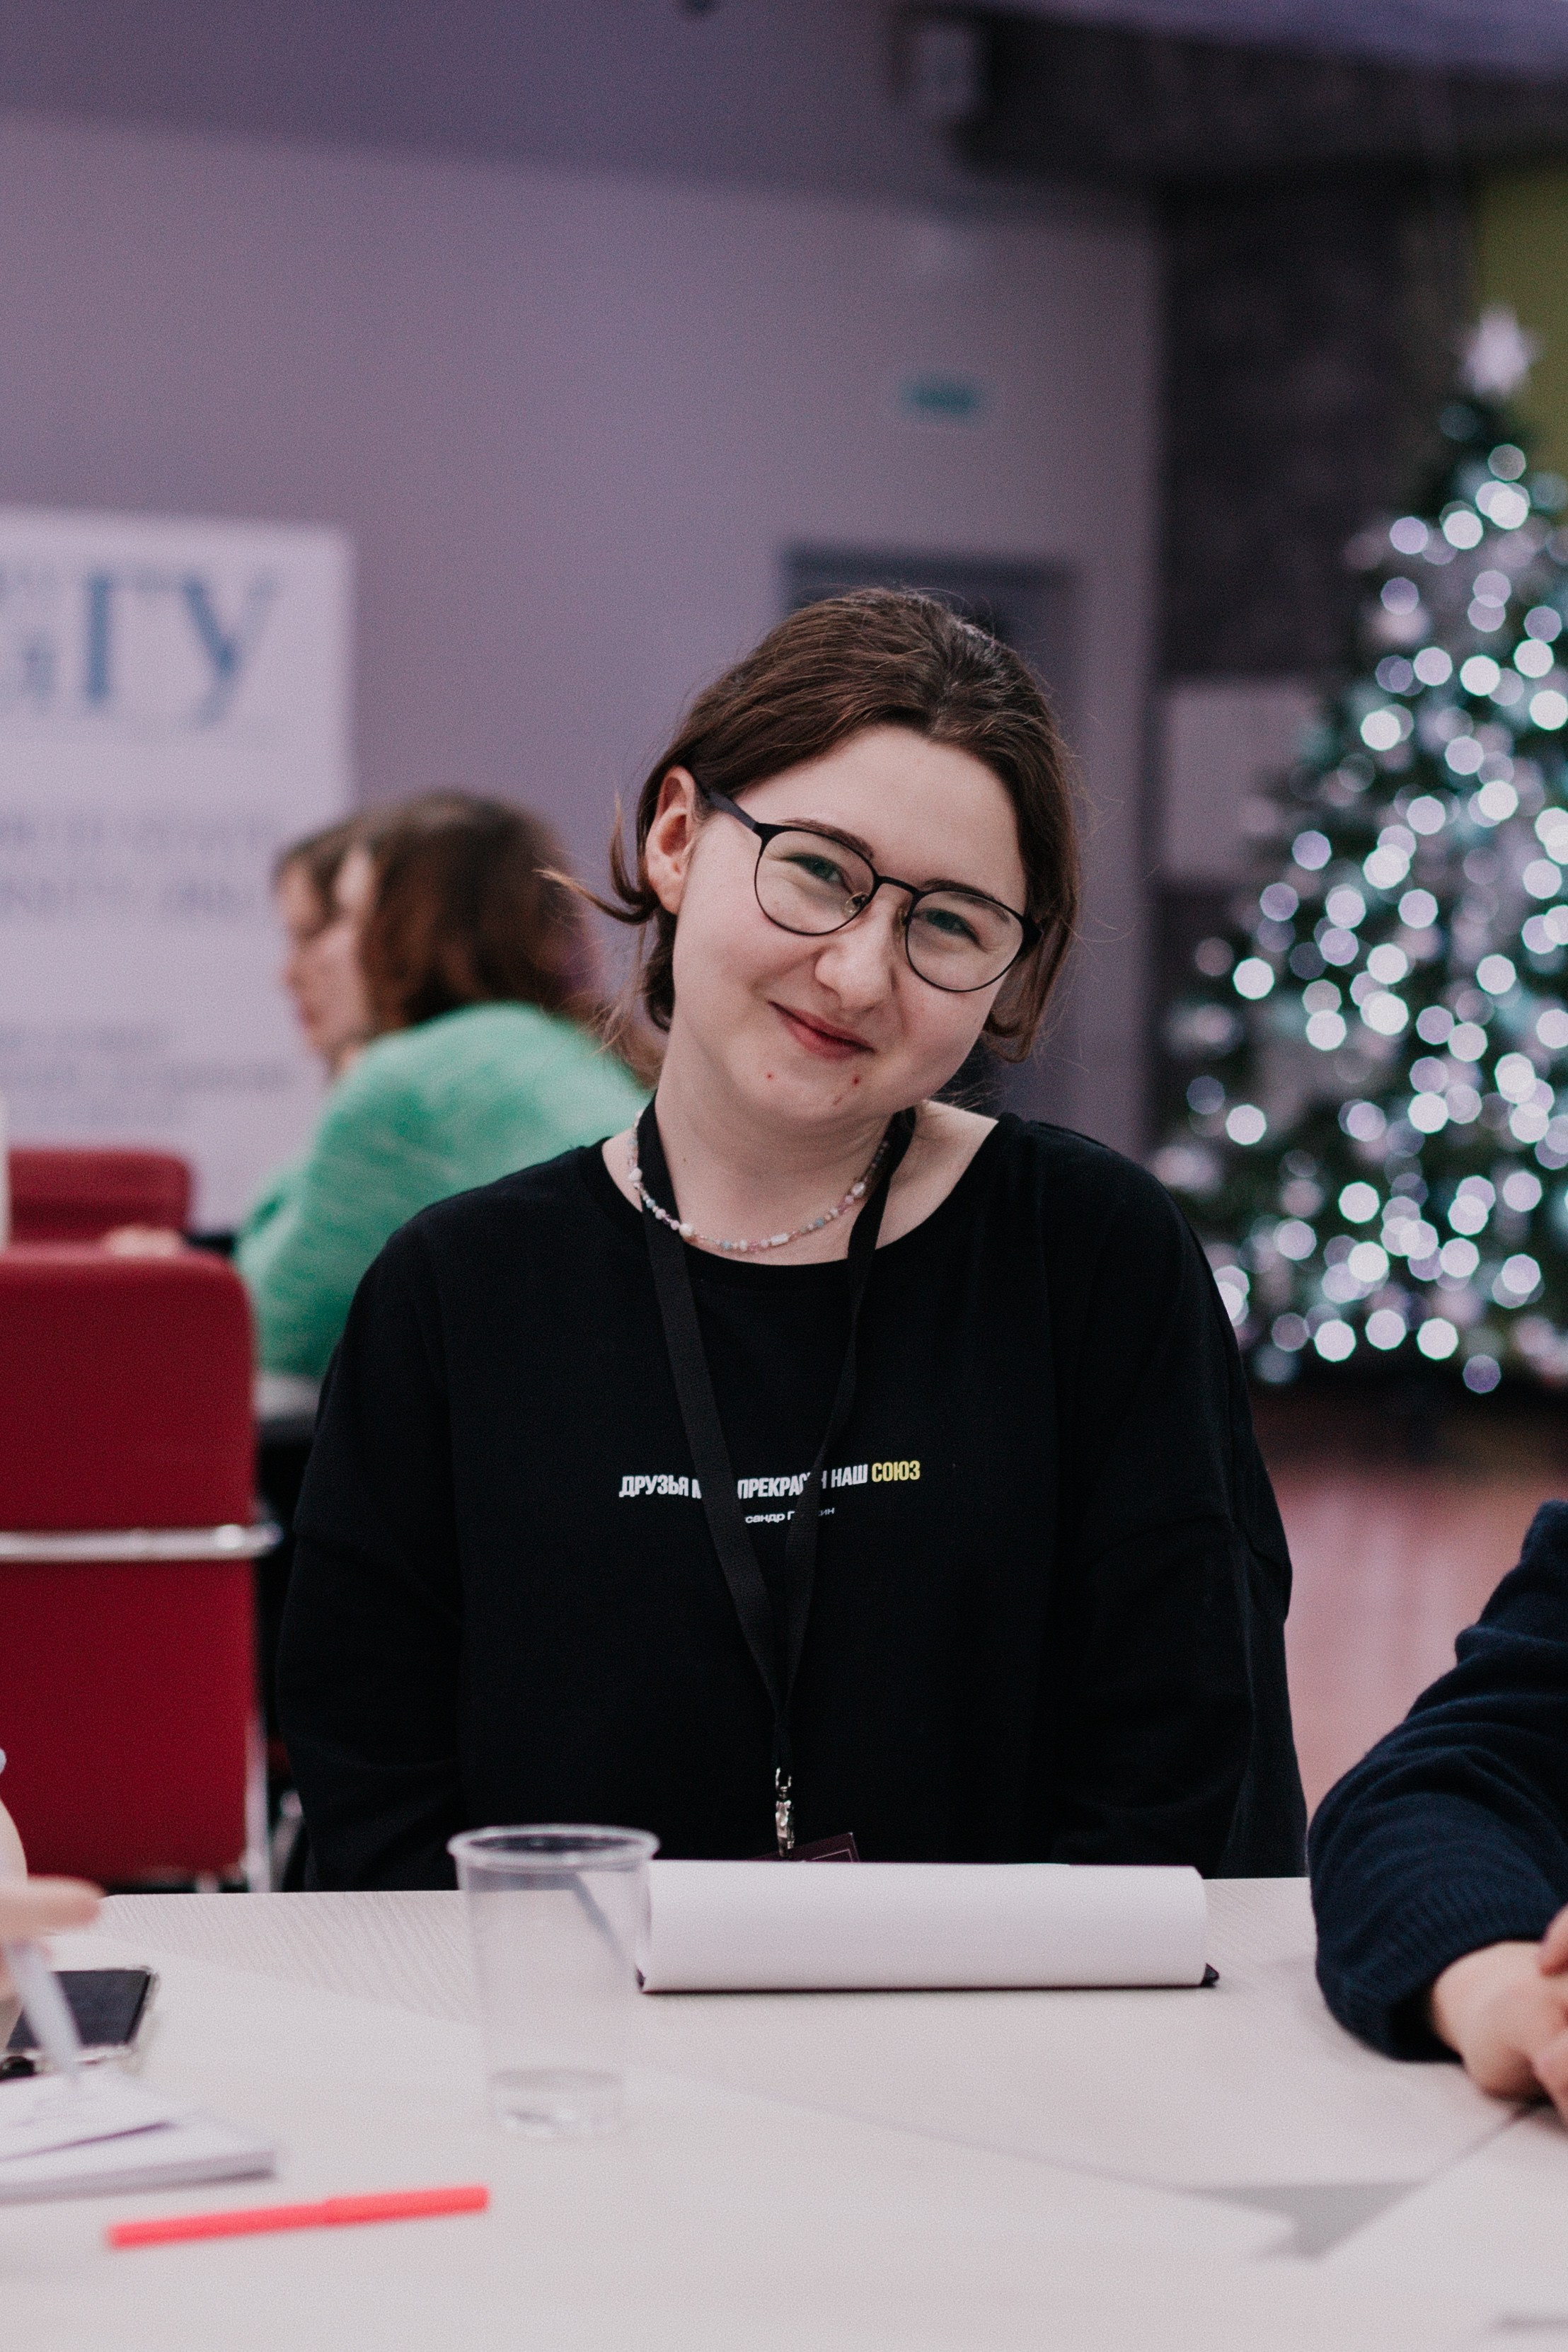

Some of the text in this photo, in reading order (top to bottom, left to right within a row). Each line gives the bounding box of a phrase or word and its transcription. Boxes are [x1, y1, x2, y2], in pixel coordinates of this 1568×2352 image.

[619, 1475, 689, 1497] ДРУЗЬЯ
[737, 1470, 828, 1499] ПРЕКРАС
[831, 1463, 868, 1488] НАШ
[872, 1460, 921, 1483] СОЮЗ
[745, 1514, 785, 1524] сандр
